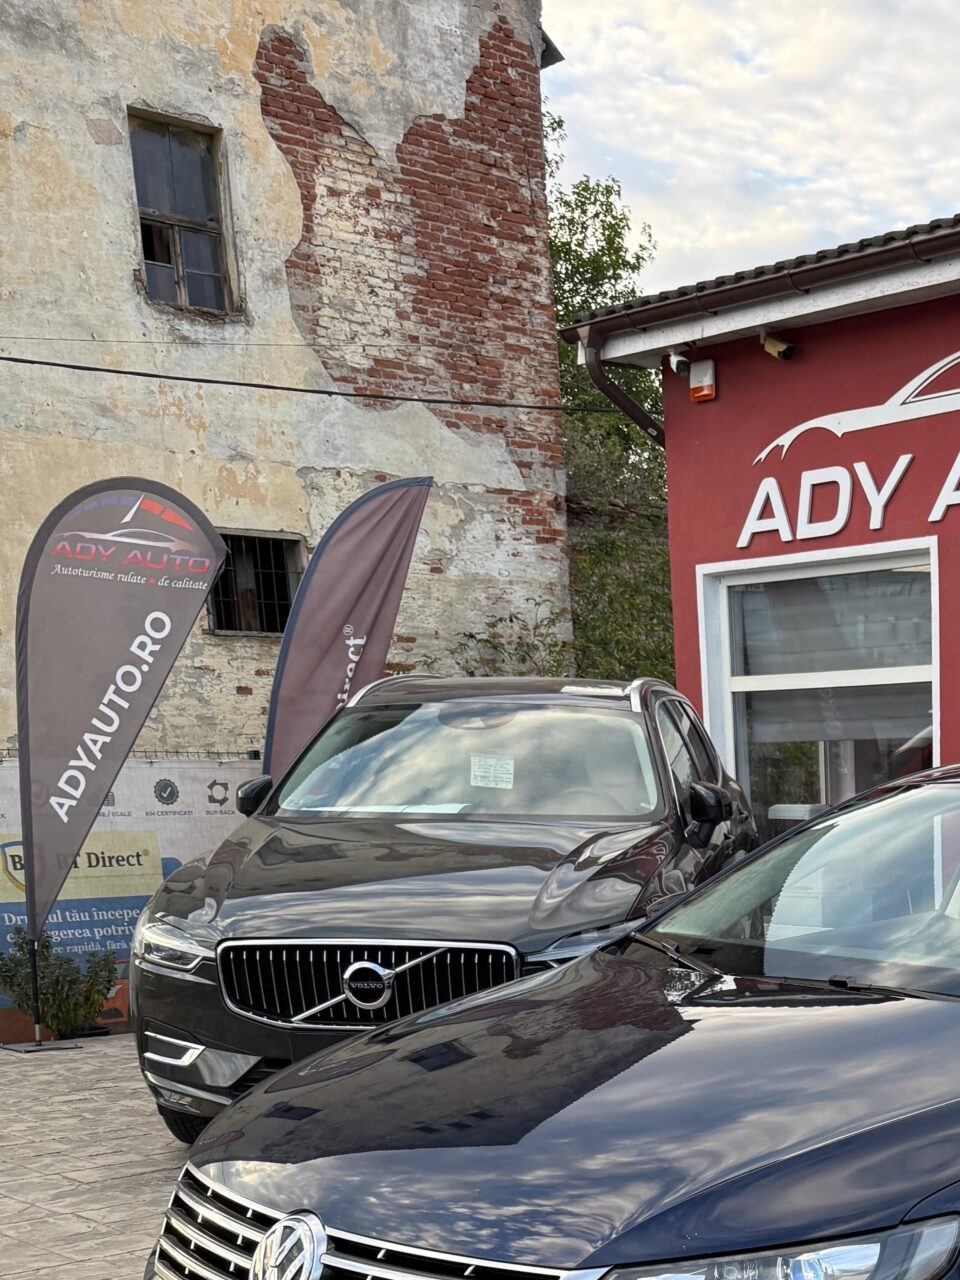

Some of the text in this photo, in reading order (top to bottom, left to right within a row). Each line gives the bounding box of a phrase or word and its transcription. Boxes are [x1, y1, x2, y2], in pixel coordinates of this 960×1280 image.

[736, 453, 914, 550] ADY
[51, 540, 211, 574] ADY AUTO
[51, 563, 209, 590] Autoturisme rulate de calitate
[48, 609, 173, 824] ADYAUTO.RO
[91, 907, 141, 922] începe
